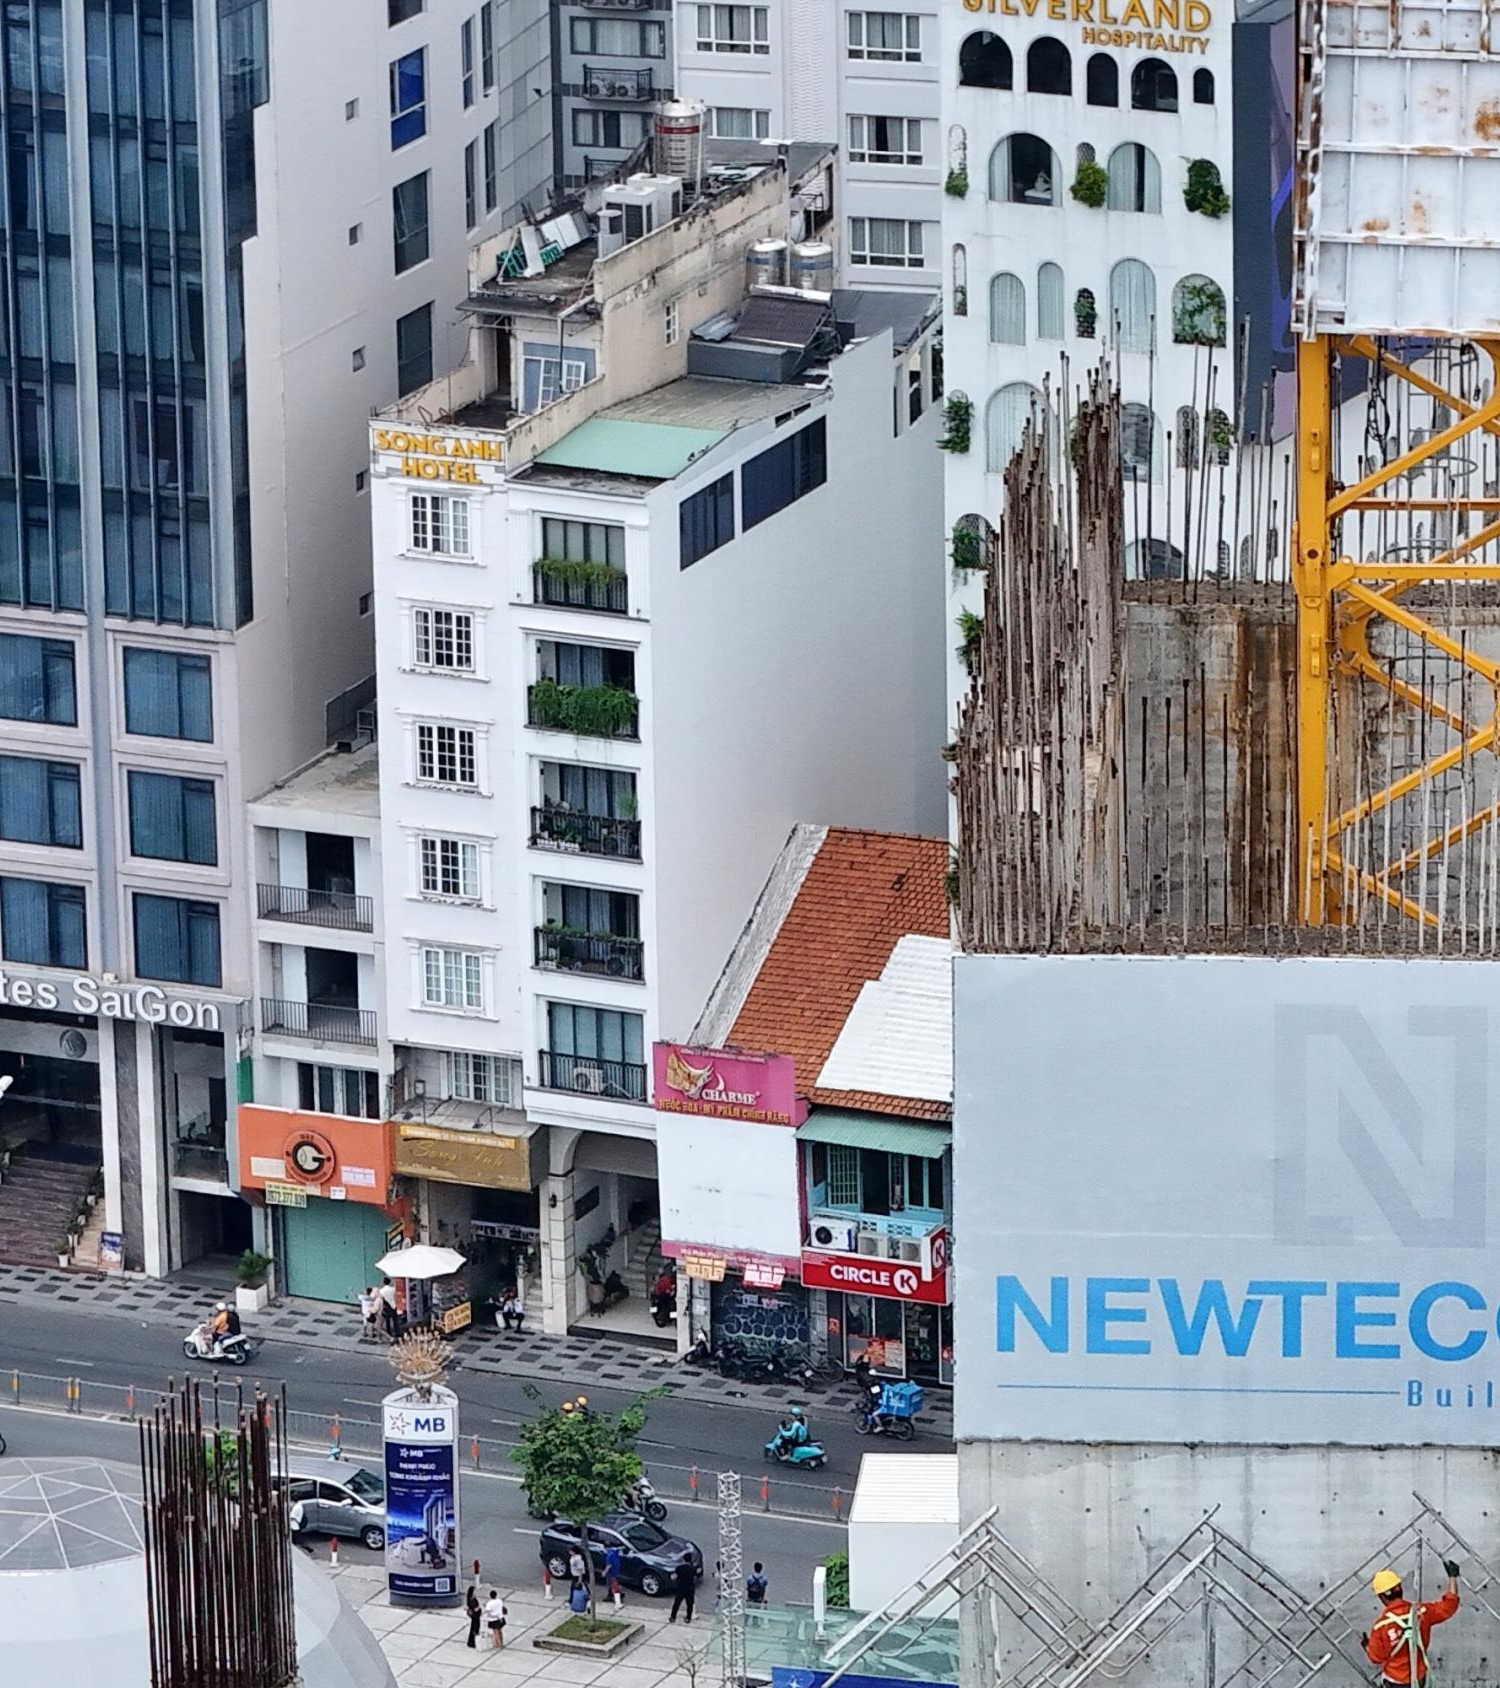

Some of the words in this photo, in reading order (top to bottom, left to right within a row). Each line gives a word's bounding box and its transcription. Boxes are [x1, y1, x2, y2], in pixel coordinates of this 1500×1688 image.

[1082, 27, 1211, 54] HOSPITALITY
[376, 429, 447, 456] SONG
[452, 437, 501, 461] ANH
[402, 456, 484, 485] HOTEL
[702, 1088, 757, 1105] CHARME
[830, 1264, 891, 1287] CIRCLE
[895, 1269, 918, 1294] K
[414, 1417, 446, 1433] MB
